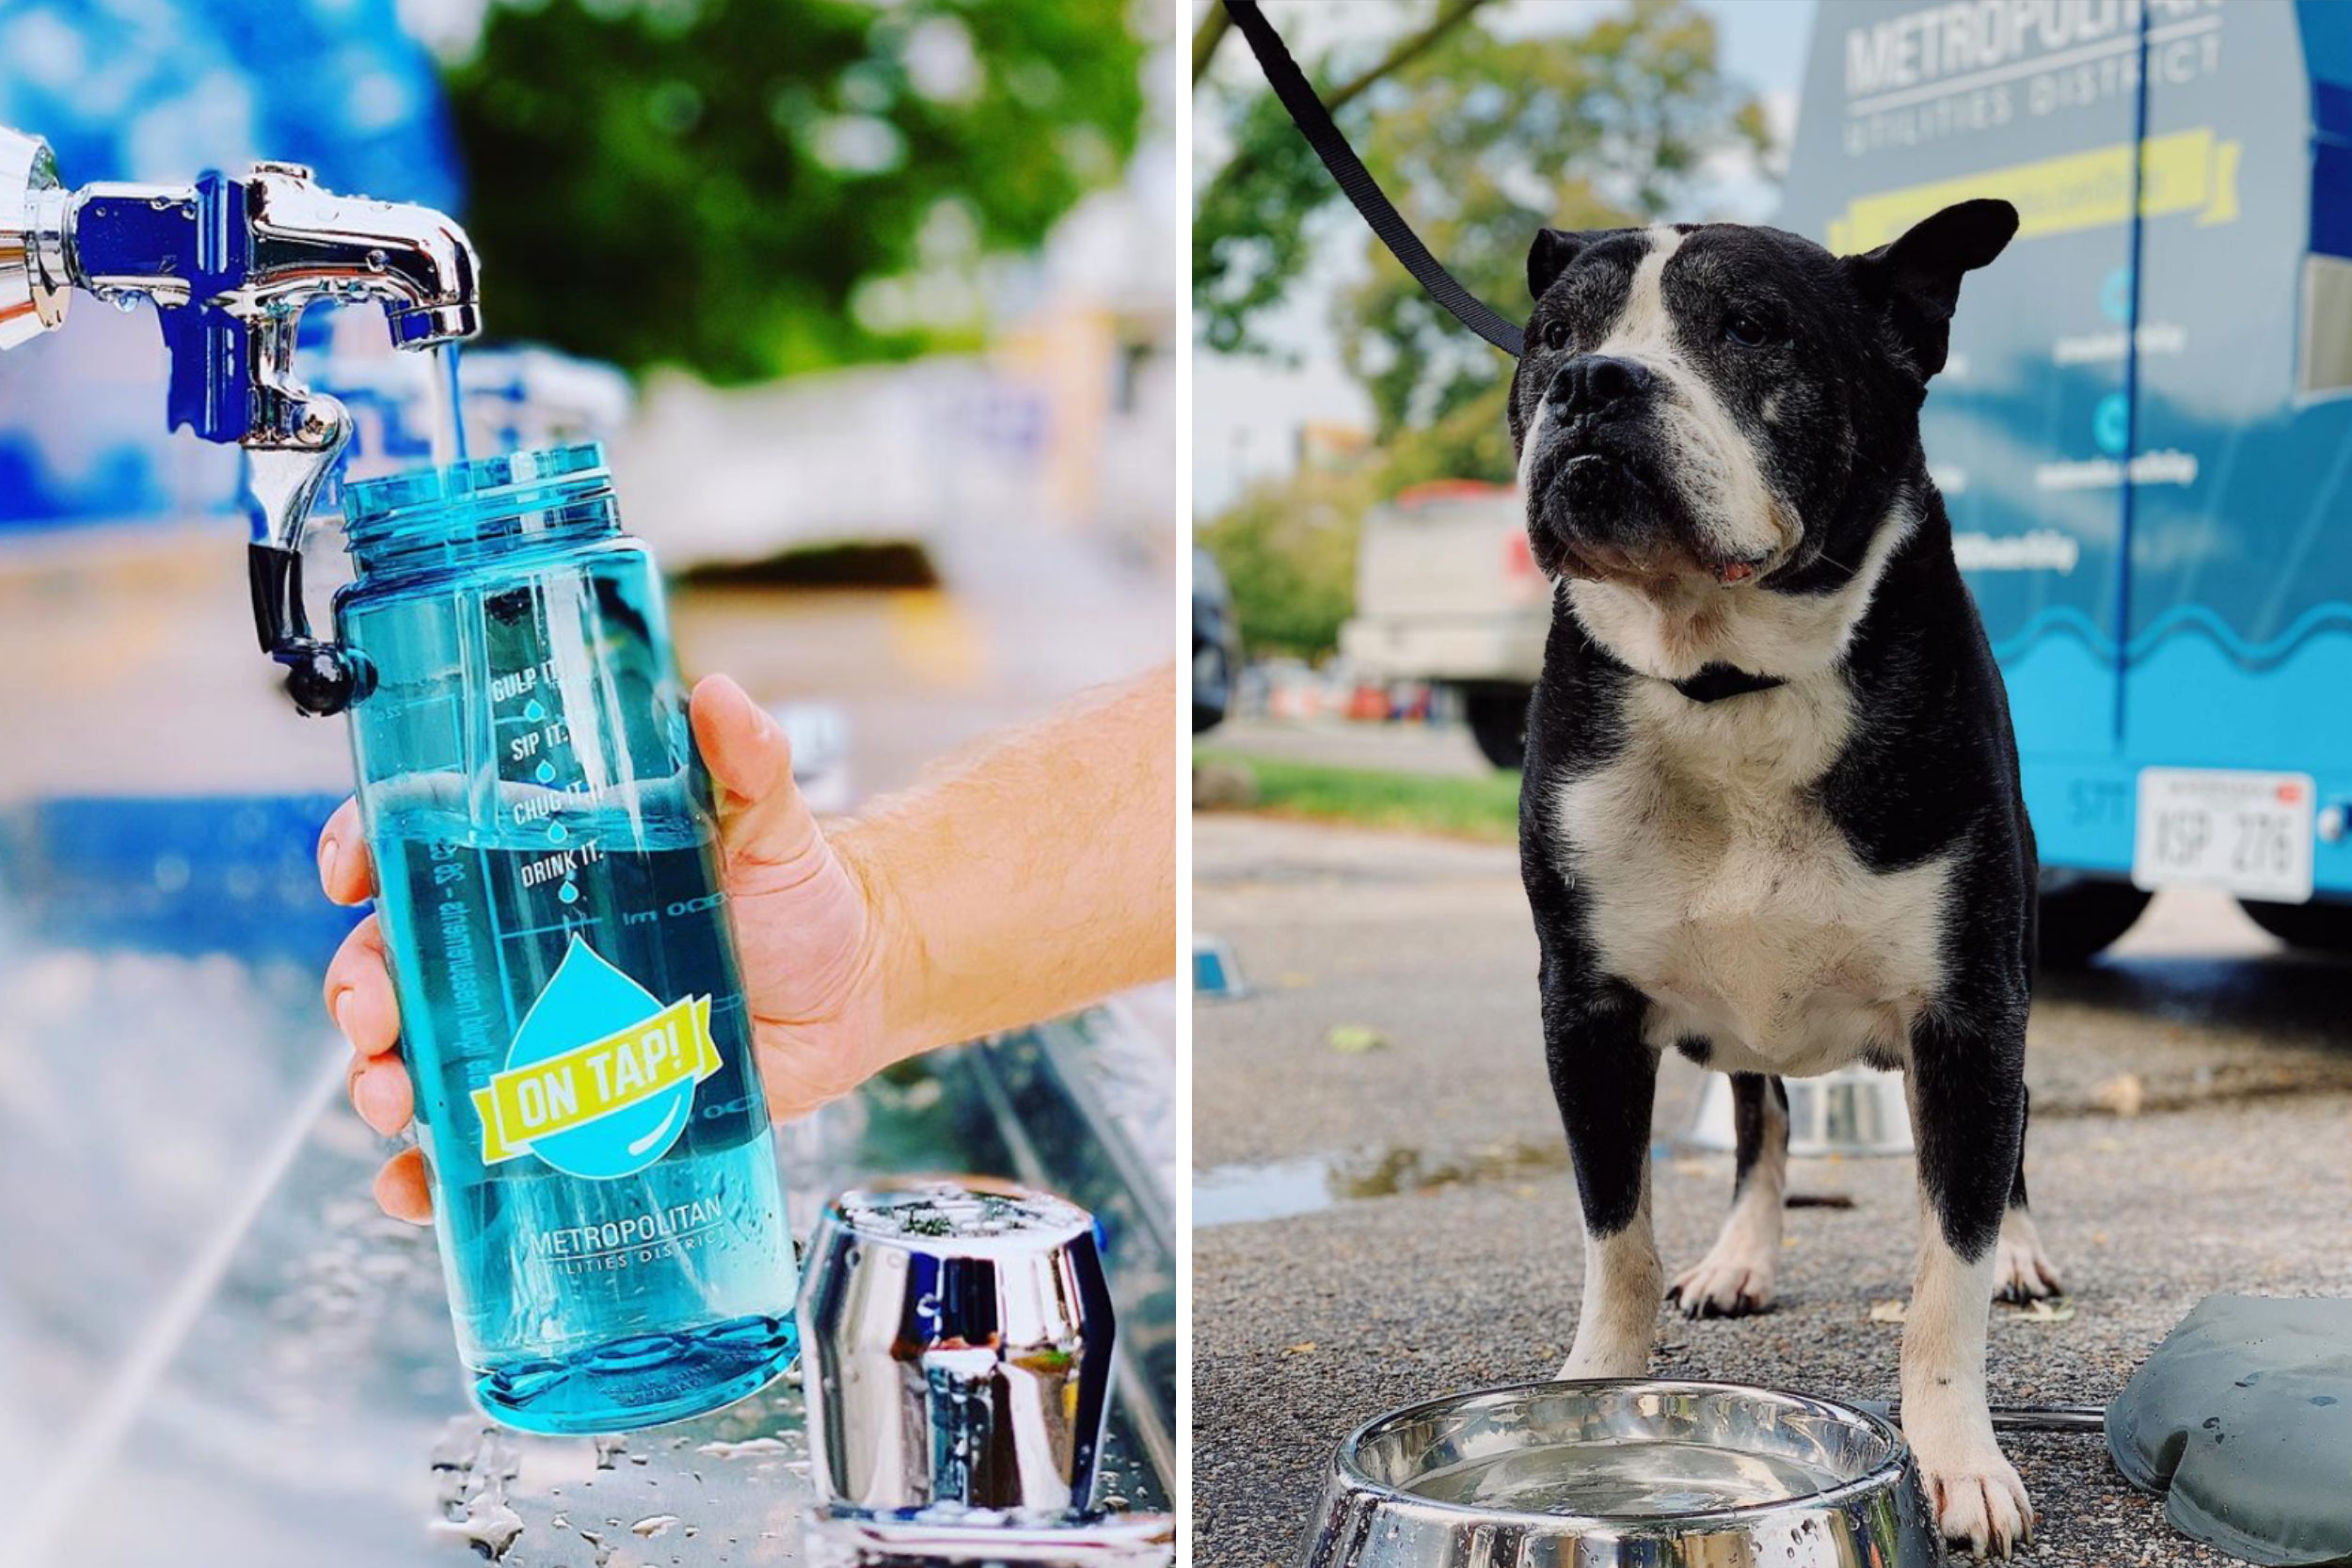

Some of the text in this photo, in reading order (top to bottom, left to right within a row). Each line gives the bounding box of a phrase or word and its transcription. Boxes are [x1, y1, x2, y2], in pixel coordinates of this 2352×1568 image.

[1844, 0, 2225, 94] METROPOL
[2029, 32, 2219, 116] DISTRICT
[492, 659, 560, 703] GULP IT
[511, 723, 568, 761] SIP IT.
[514, 790, 562, 826] CHUG
[521, 838, 603, 888] DRINK IT.
[516, 1069, 580, 1128] ON
[585, 1021, 683, 1103] TAP!
[530, 1194, 723, 1256] METROPOLITAN
[538, 1226, 724, 1276] TILITIES DISRICT
